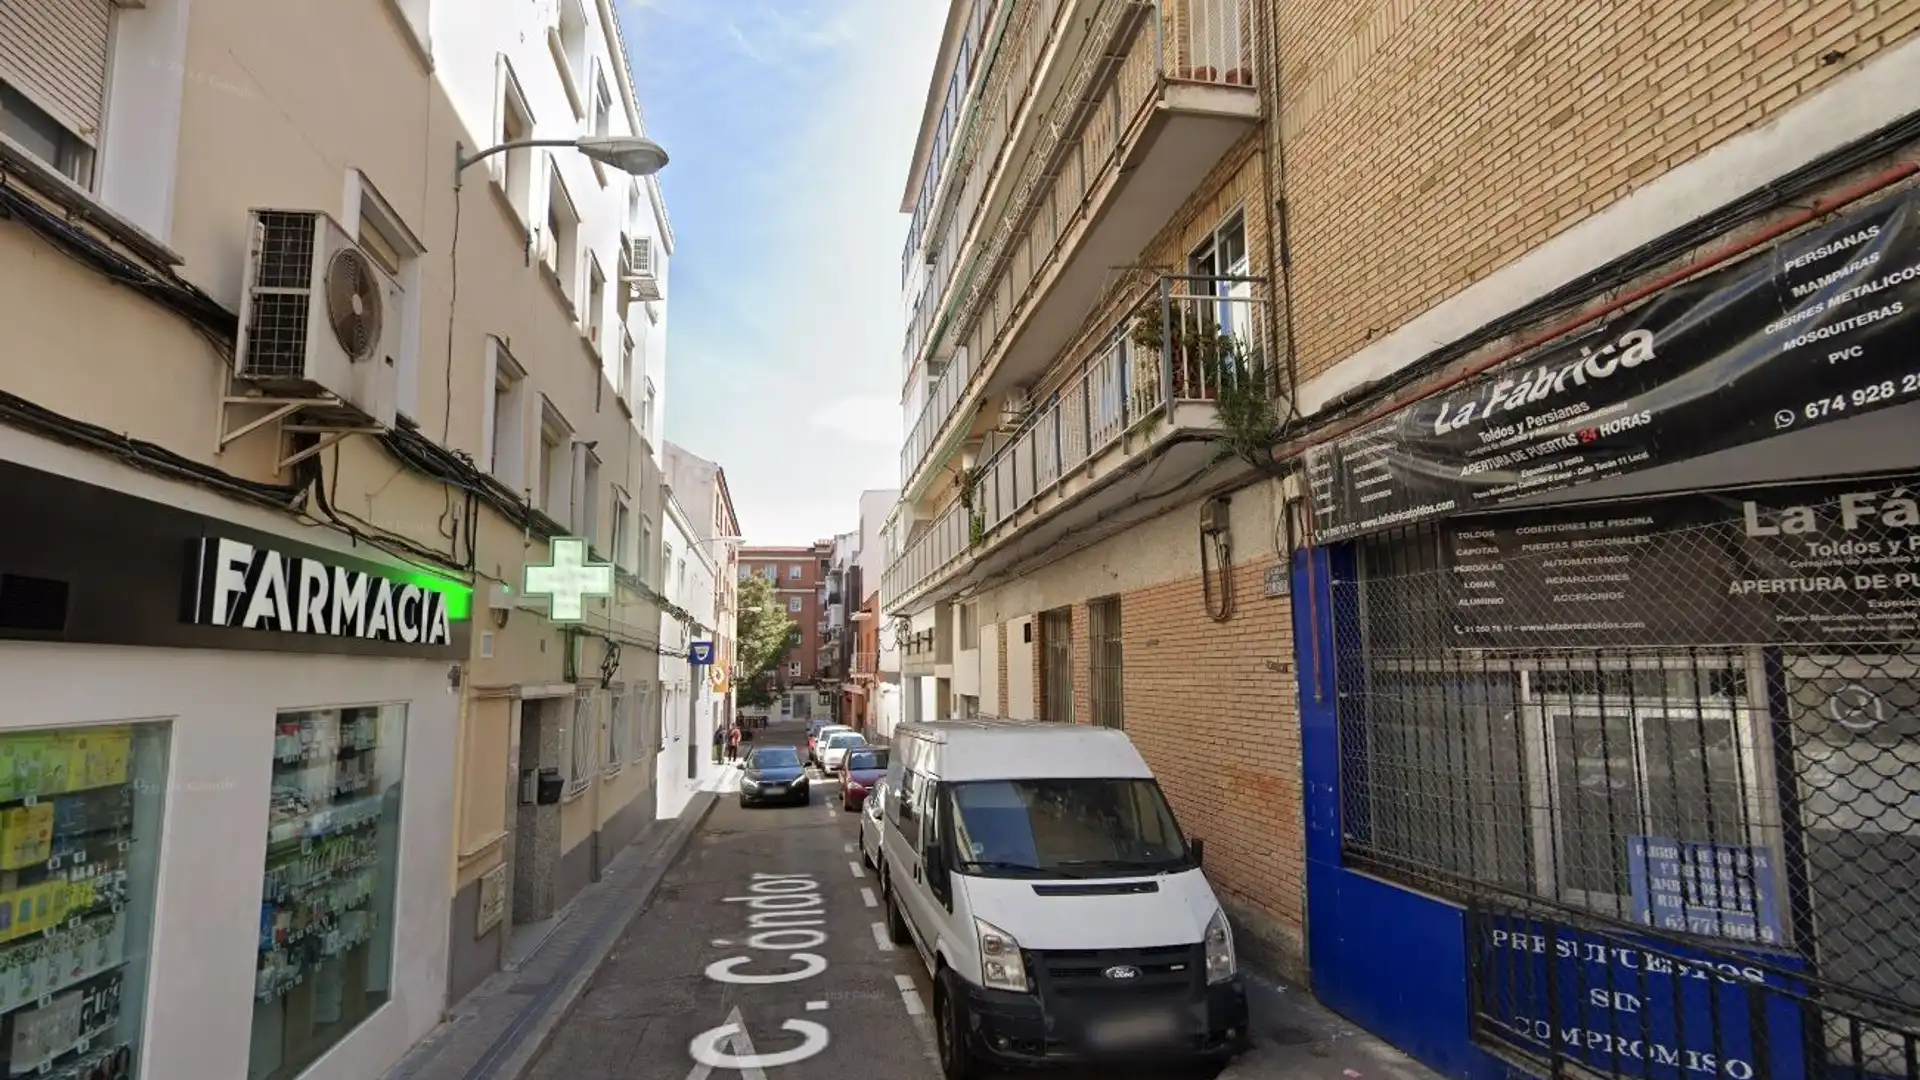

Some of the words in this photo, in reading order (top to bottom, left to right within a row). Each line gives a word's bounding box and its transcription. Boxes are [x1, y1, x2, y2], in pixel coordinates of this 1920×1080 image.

[1784, 225, 1880, 272] PERSIANAS
[1791, 252, 1880, 298] MAMPARAS
[1765, 302, 1824, 335] CIERRES
[1783, 301, 1904, 351] MOSQUITERAS
[1828, 345, 1864, 366] PVC
[1434, 401, 1477, 436] La
[1482, 329, 1657, 418] Fábrica
[1805, 394, 1846, 419] 674
[1852, 380, 1896, 406] 928
[1902, 373, 1920, 393] 2
[1478, 425, 1516, 444] Toldos
[1516, 421, 1524, 434] y
[1525, 401, 1591, 429] Persianas
[1460, 453, 1514, 477] APERTURA
[1511, 449, 1529, 462] DE
[1526, 432, 1579, 458] PUERTAS
[1579, 427, 1599, 442] 24
[1600, 409, 1652, 437] HORAS
[1458, 530, 1495, 539] TOLDOS
[1516, 522, 1587, 535] COBERTORES
[1589, 520, 1604, 529] DE
[1608, 516, 1654, 528] PISCINA
[1743, 500, 1818, 537] La
[1456, 547, 1499, 556] CAPOTAS
[1522, 541, 1568, 551] PUERTAS
[1572, 535, 1650, 548] SECCIONALES
[1542, 555, 1630, 567] AUTOMATISMOS
[1806, 540, 1881, 557] Toldos
[1887, 540, 1900, 556] y
[211, 537, 451, 646] FARMACIA
[1545, 573, 1630, 584] REPARACIONES
[1728, 576, 1849, 595] APERTURA
[1855, 573, 1888, 590] DE
[1553, 591, 1625, 602] ACCESORIOS
